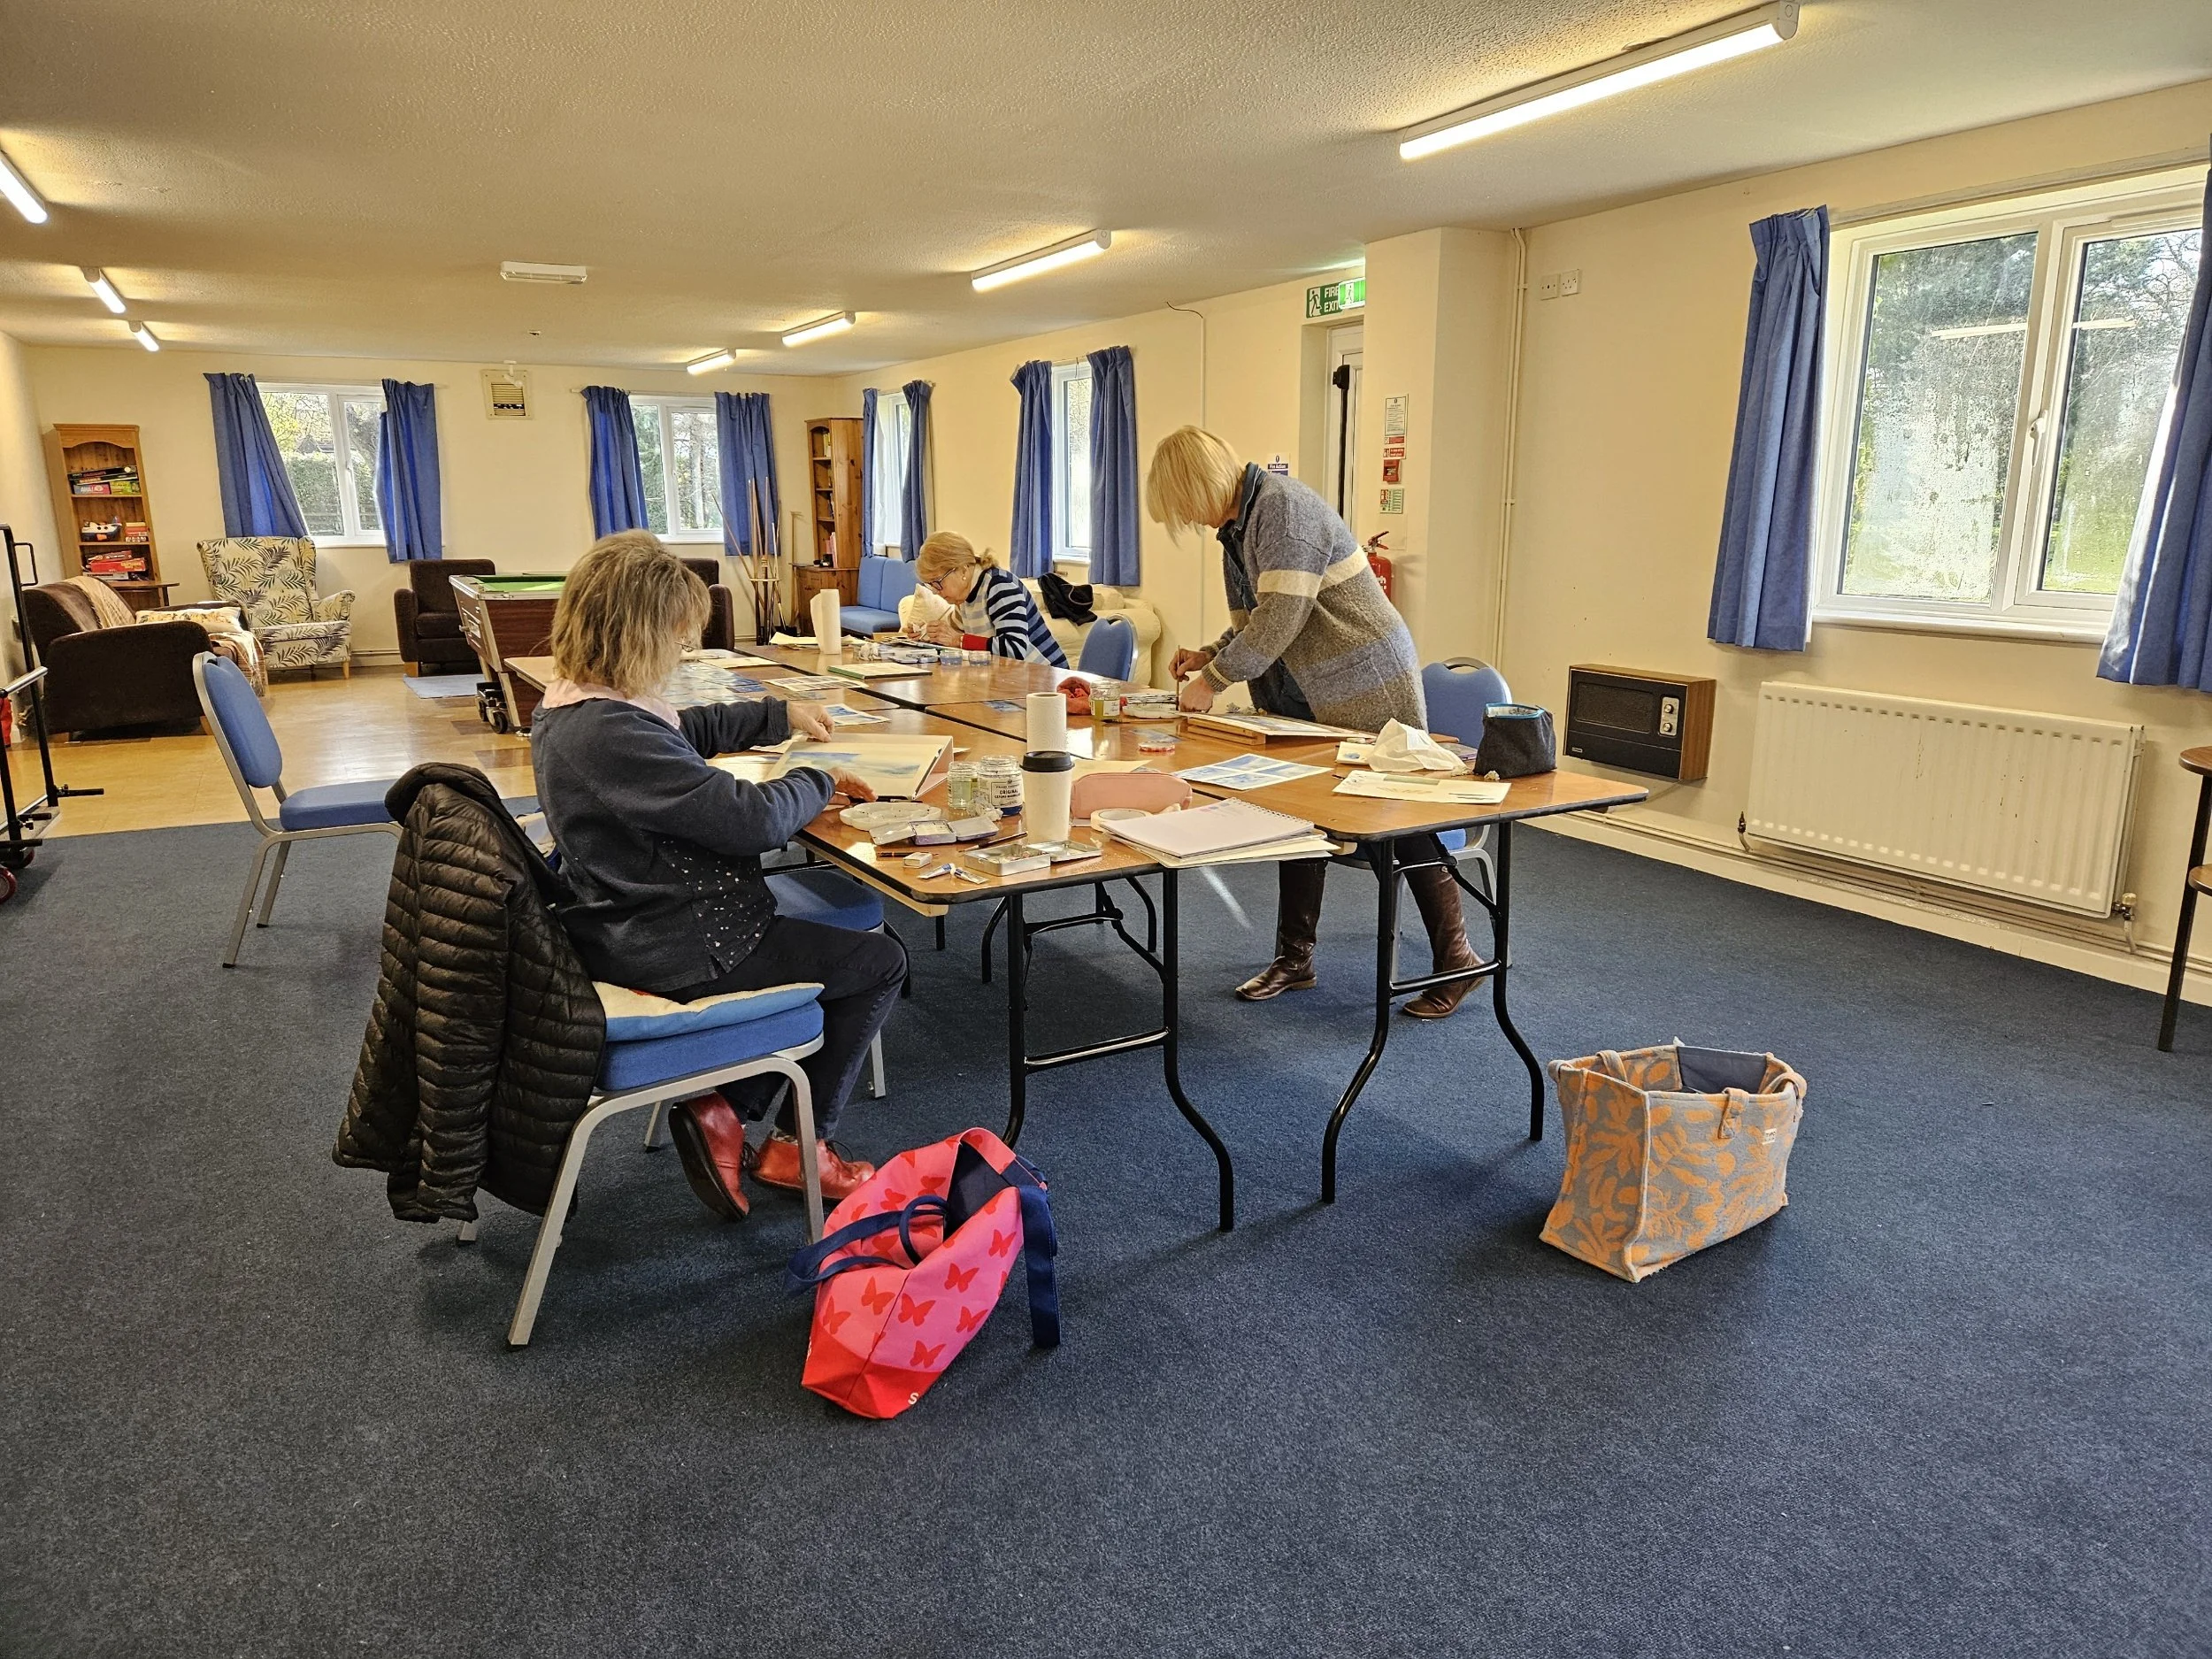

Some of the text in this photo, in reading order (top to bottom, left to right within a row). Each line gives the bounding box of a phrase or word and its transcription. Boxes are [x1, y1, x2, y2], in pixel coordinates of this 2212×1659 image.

[1325, 286, 1339, 298] FIRE
[1325, 301, 1339, 312] EXIT
[908, 1392, 919, 1405] S
